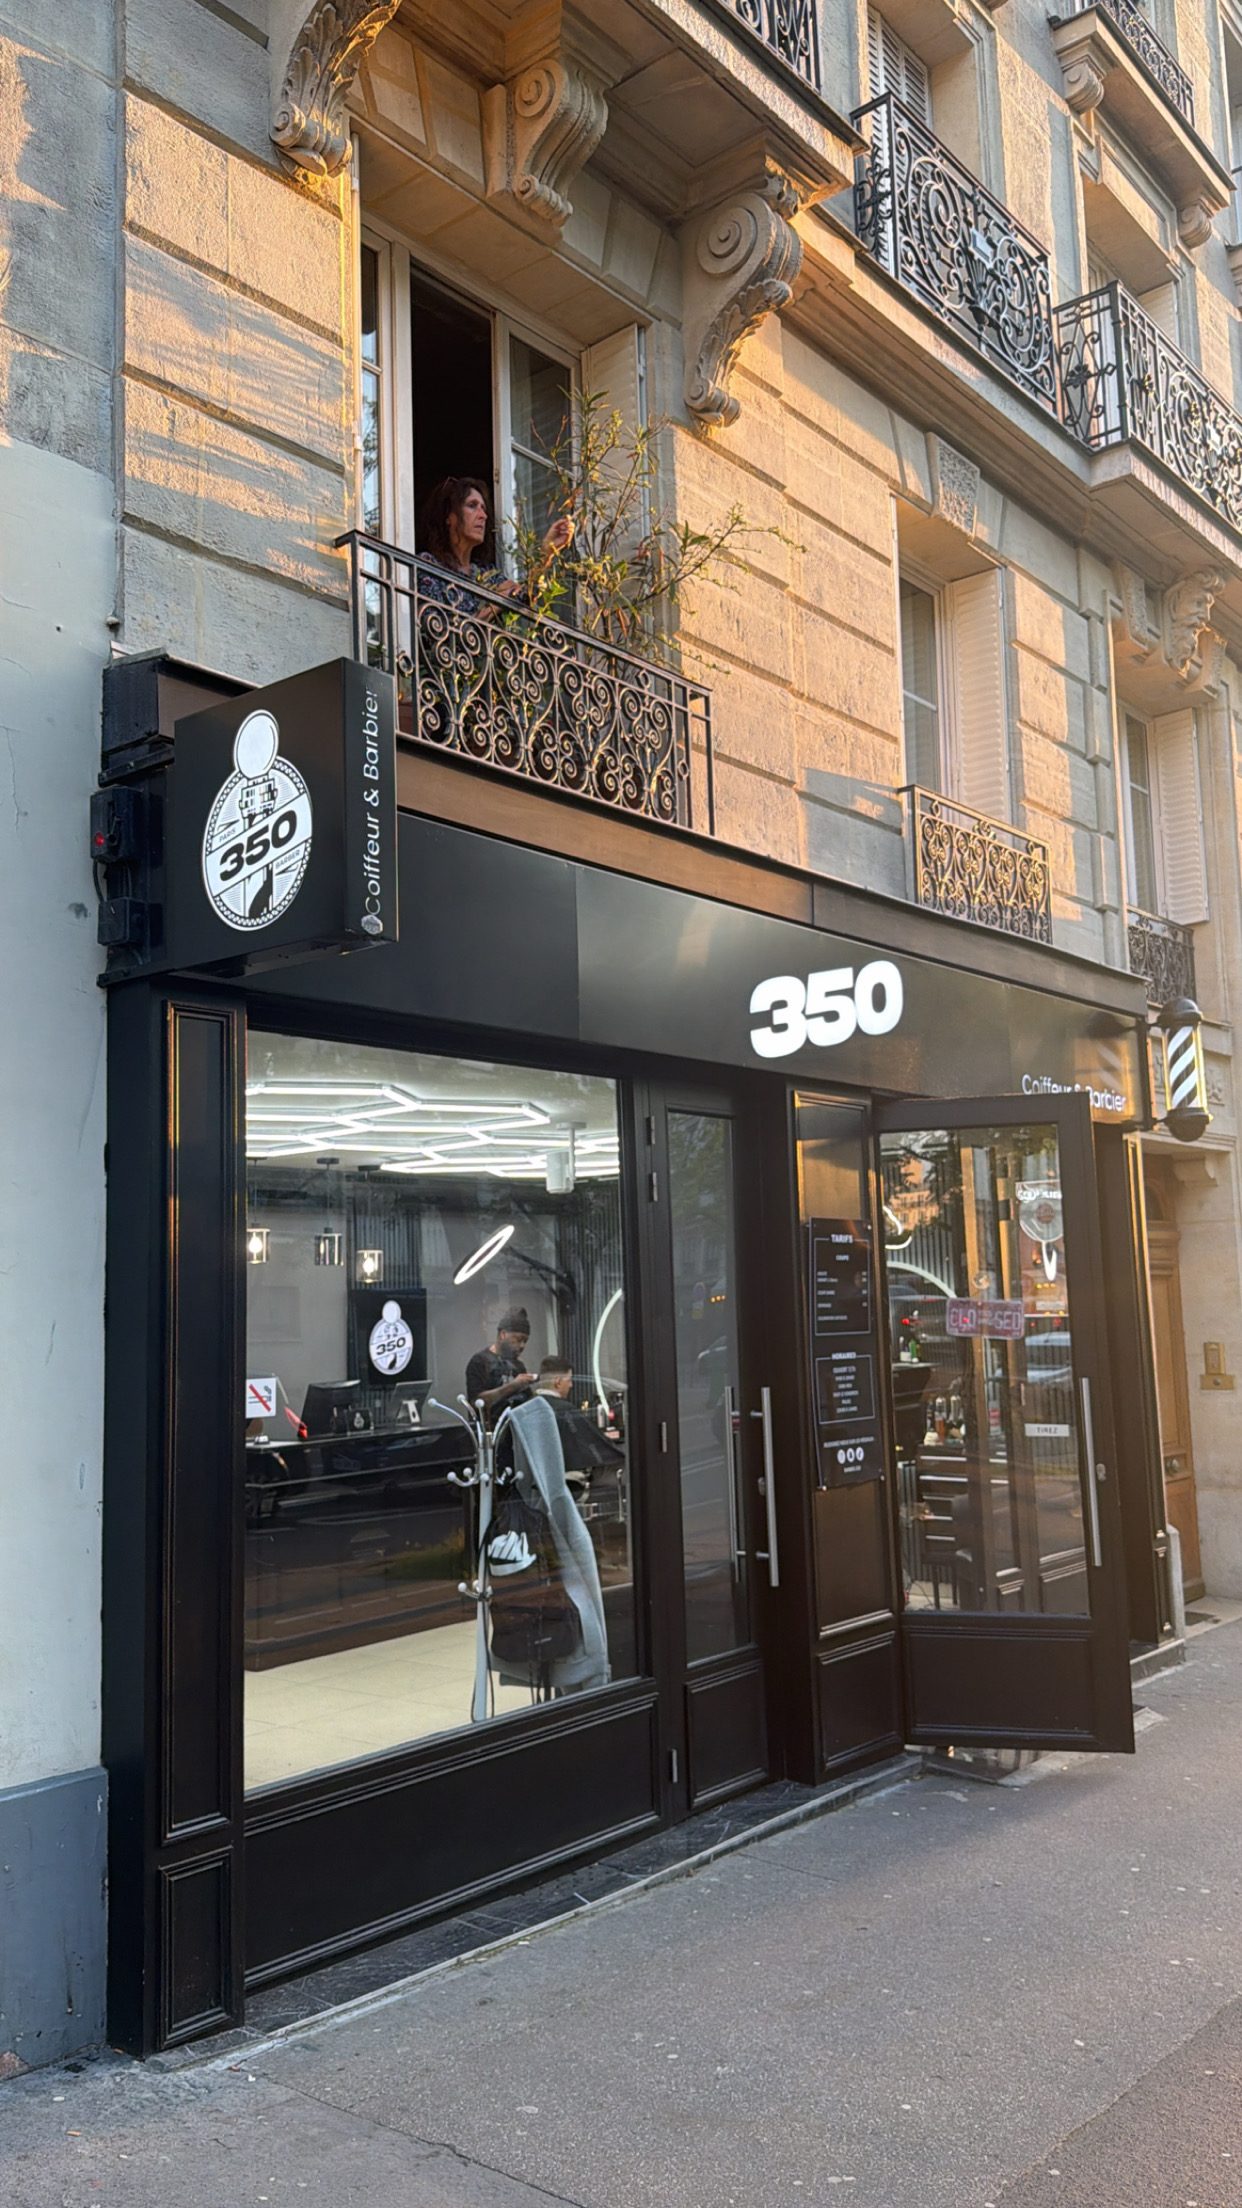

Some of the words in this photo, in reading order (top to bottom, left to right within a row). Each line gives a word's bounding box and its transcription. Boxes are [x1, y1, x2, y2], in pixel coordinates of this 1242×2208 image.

[363, 788, 380, 807] &
[219, 809, 298, 882] 350
[275, 848, 301, 870] BARBER
[362, 811, 381, 915] Coiffeur
[749, 960, 904, 1059] 350
[831, 1233, 853, 1243] TARIFS
[376, 1336, 406, 1356] 350
